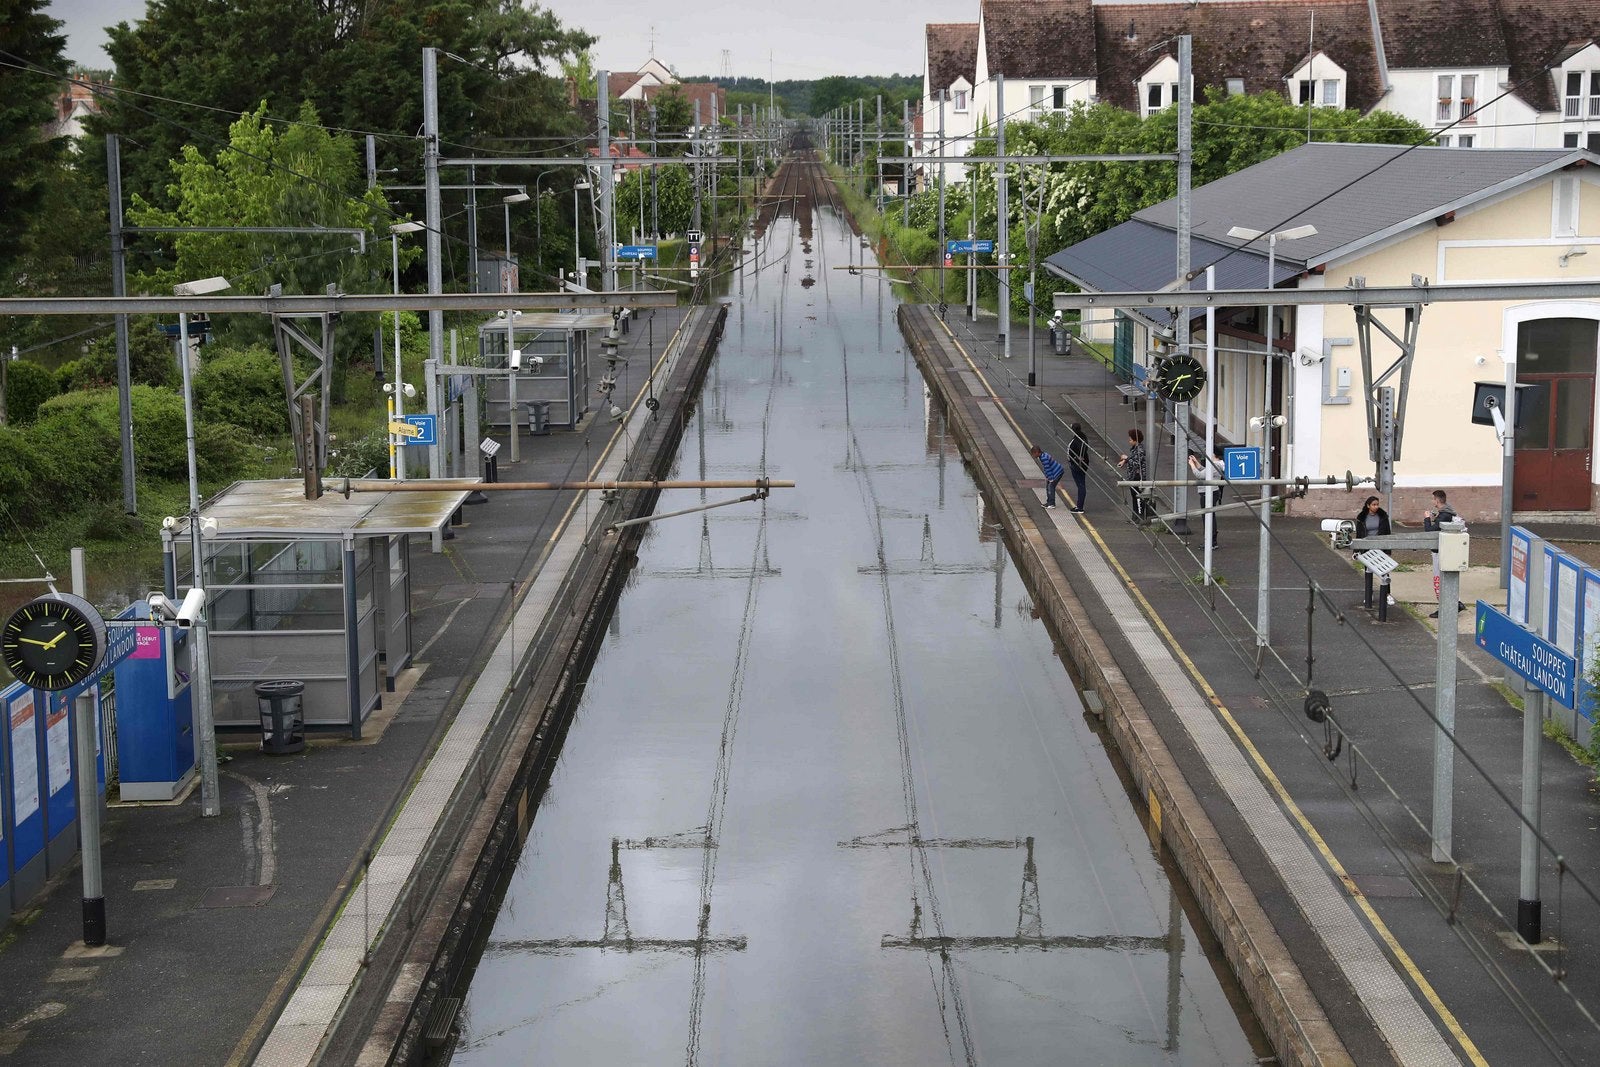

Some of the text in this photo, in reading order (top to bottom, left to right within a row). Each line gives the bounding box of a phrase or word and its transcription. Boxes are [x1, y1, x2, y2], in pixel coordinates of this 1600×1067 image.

[417, 427, 424, 439] 2
[1239, 462, 1245, 475] 1
[110, 633, 134, 663] LANDON
[1532, 643, 1566, 678] SOUPPES
[1500, 641, 1566, 699] CHÂTEAU LANDON
